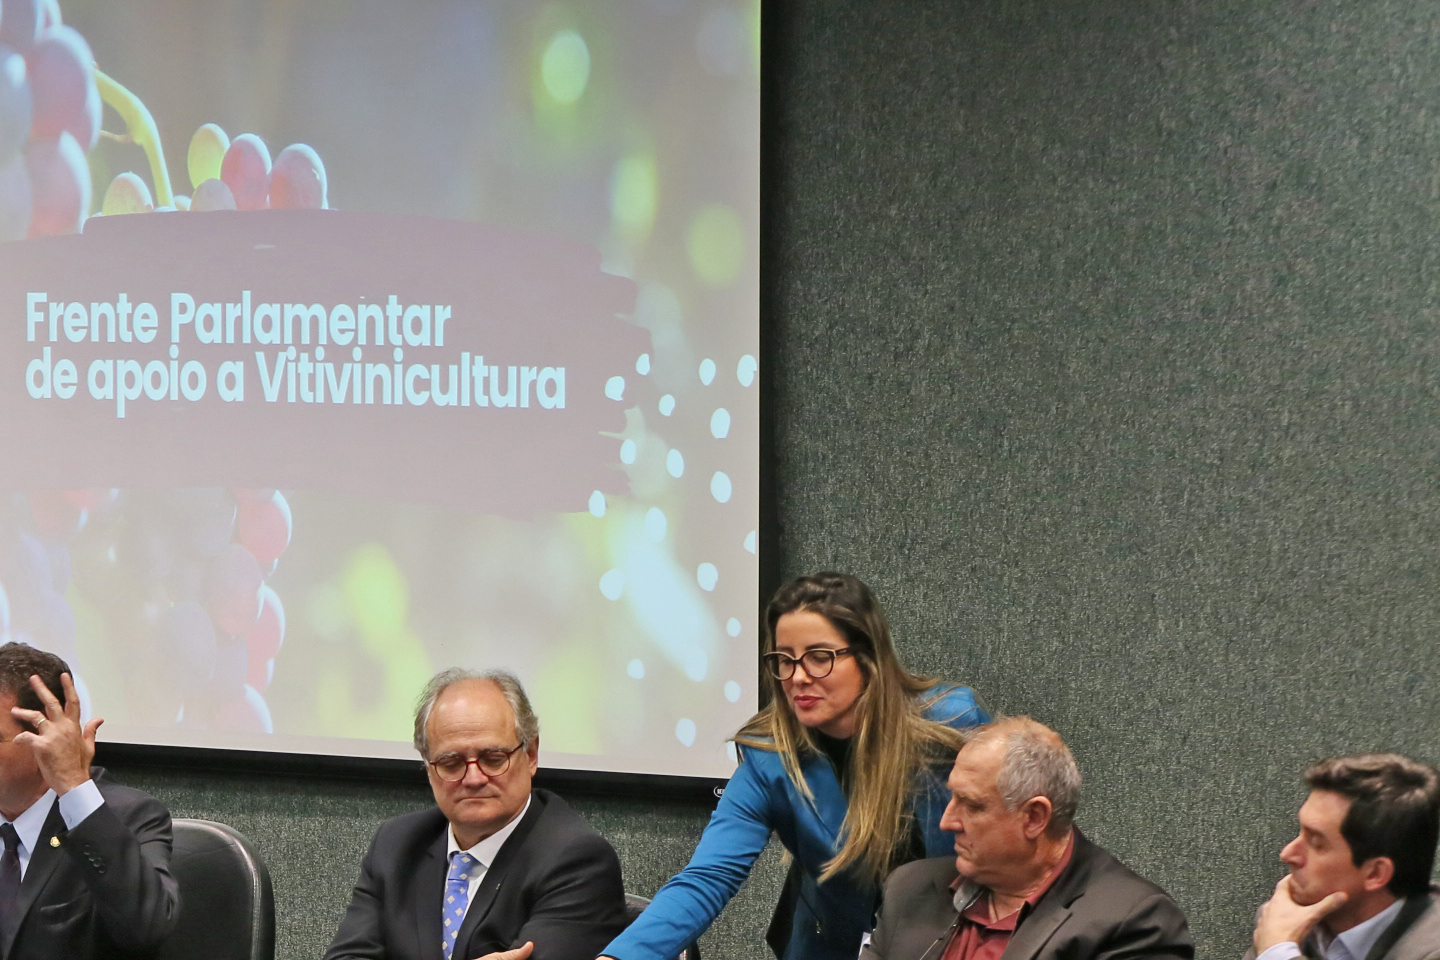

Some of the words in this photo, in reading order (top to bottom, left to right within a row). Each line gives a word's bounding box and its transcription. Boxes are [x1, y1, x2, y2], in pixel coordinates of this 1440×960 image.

[25, 292, 158, 344] Frente
[170, 290, 451, 347] Parlamentar
[25, 346, 78, 401] de
[87, 345, 207, 418] apoio
[216, 359, 245, 402] a
[255, 345, 566, 409] Vitivinicultura
